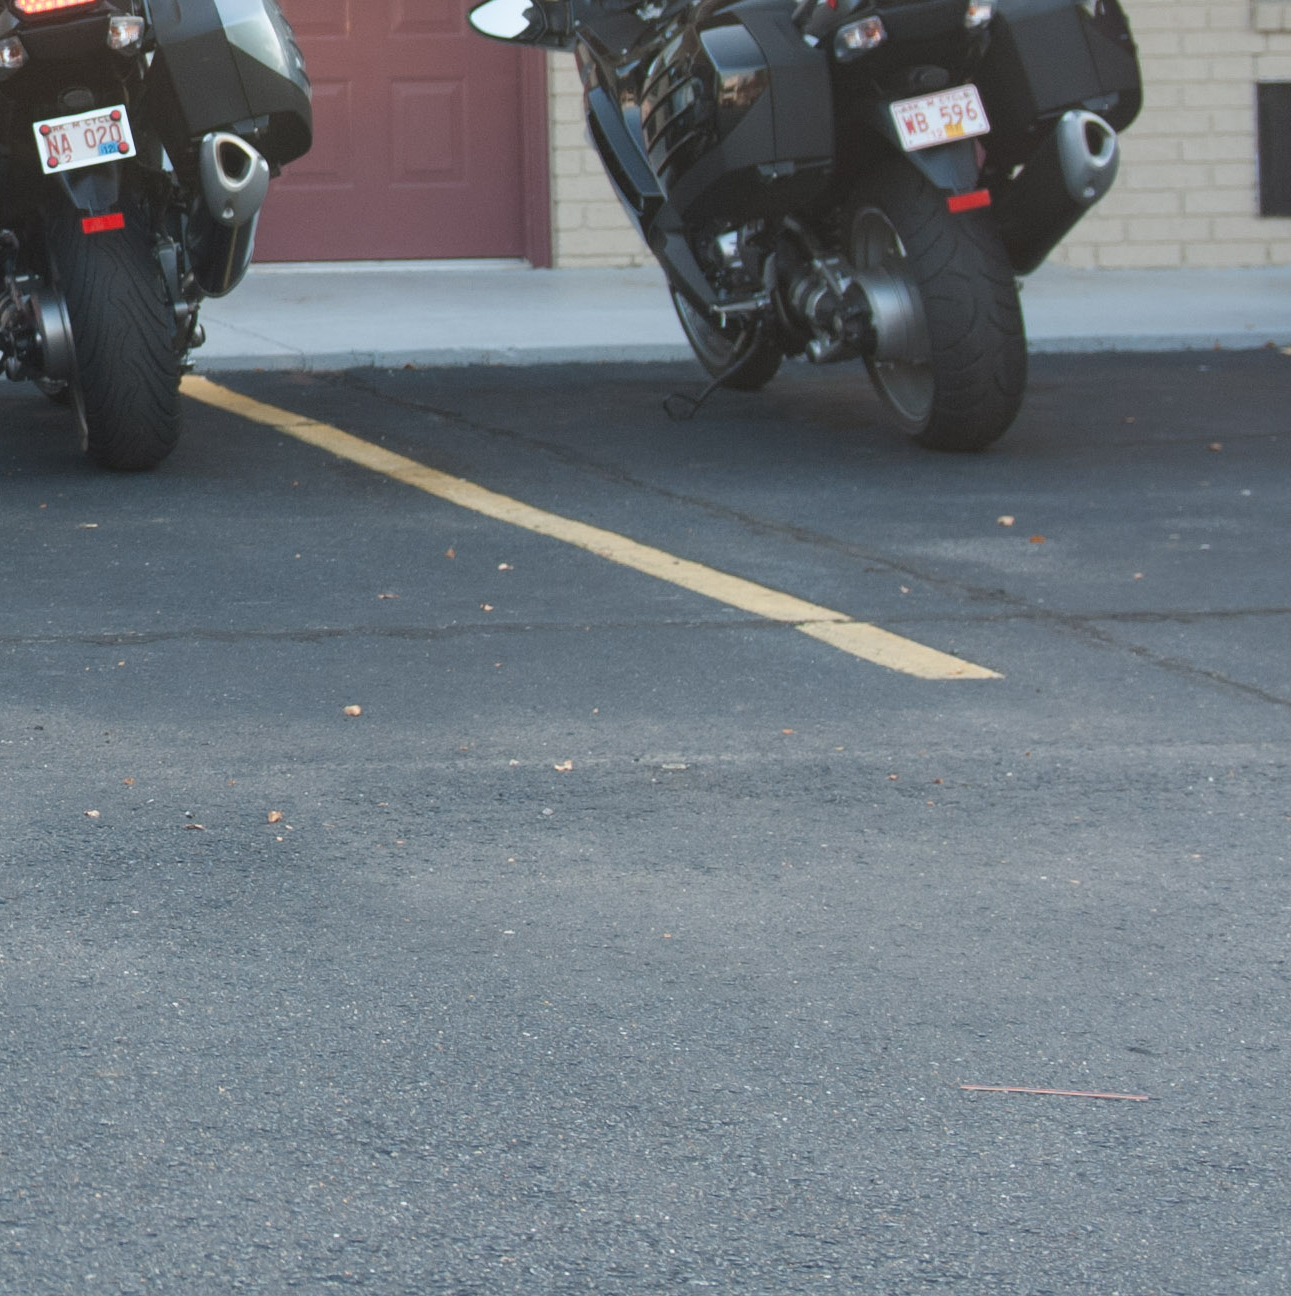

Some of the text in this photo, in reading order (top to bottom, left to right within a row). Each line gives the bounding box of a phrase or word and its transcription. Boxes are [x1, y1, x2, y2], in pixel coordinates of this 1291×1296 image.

[902, 111, 930, 137] WB
[939, 100, 979, 127] 596
[45, 122, 122, 157] NA 020
